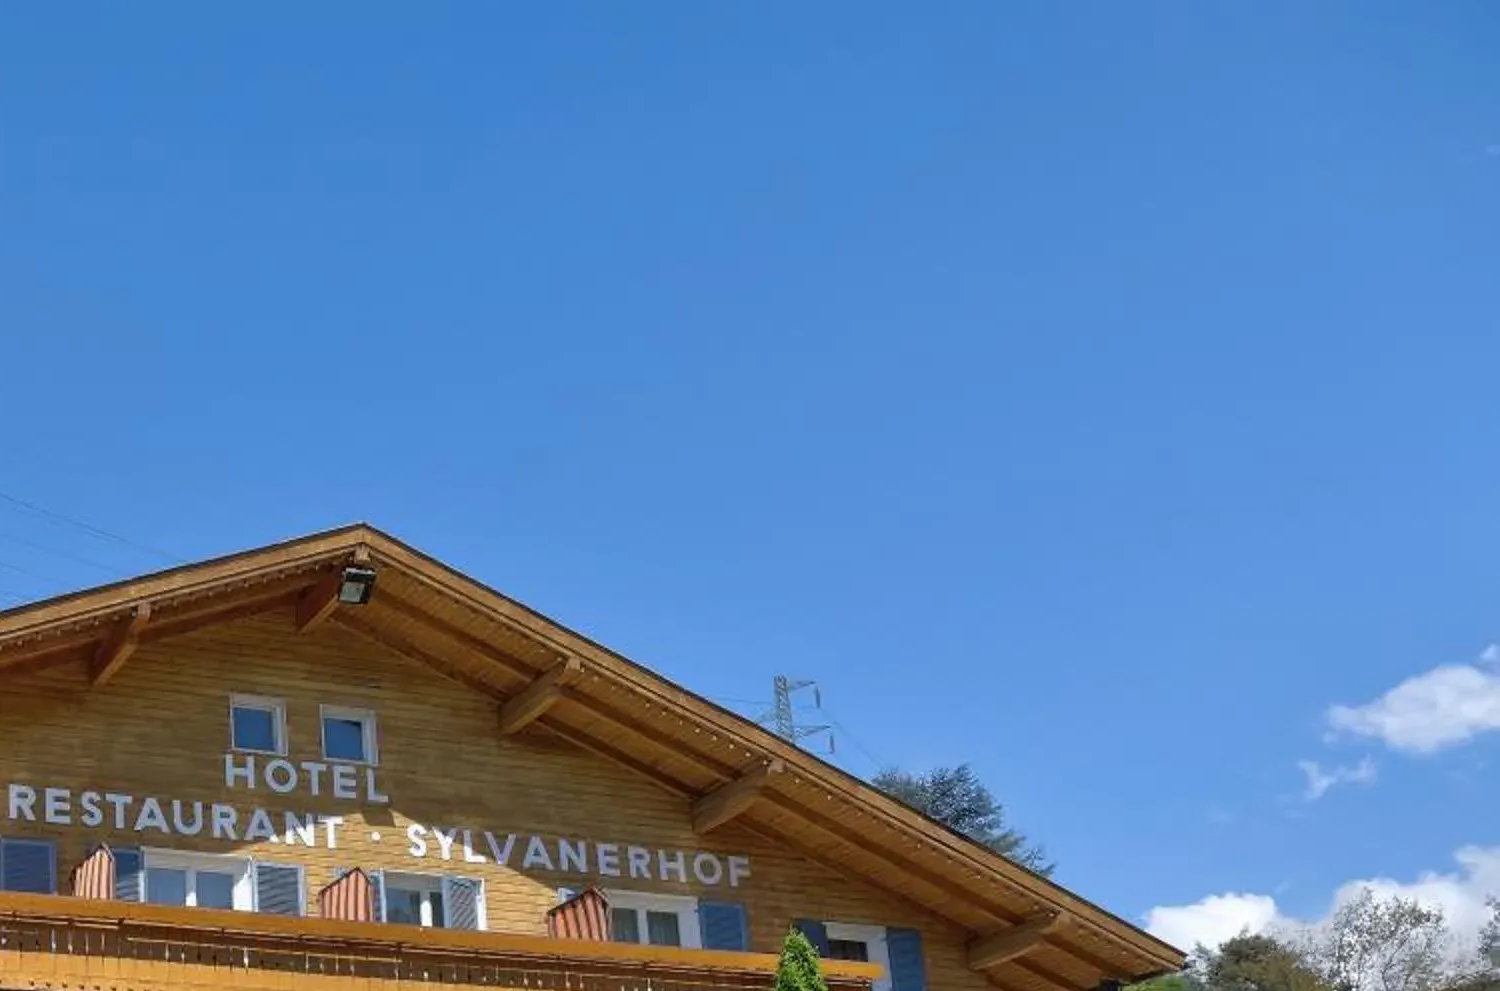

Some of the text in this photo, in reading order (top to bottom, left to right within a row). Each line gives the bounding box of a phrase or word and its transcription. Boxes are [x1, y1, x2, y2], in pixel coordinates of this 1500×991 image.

[225, 754, 388, 803] HOTEL
[8, 784, 343, 849] RESTAURANT
[406, 823, 751, 887] SYLVANERHOF
